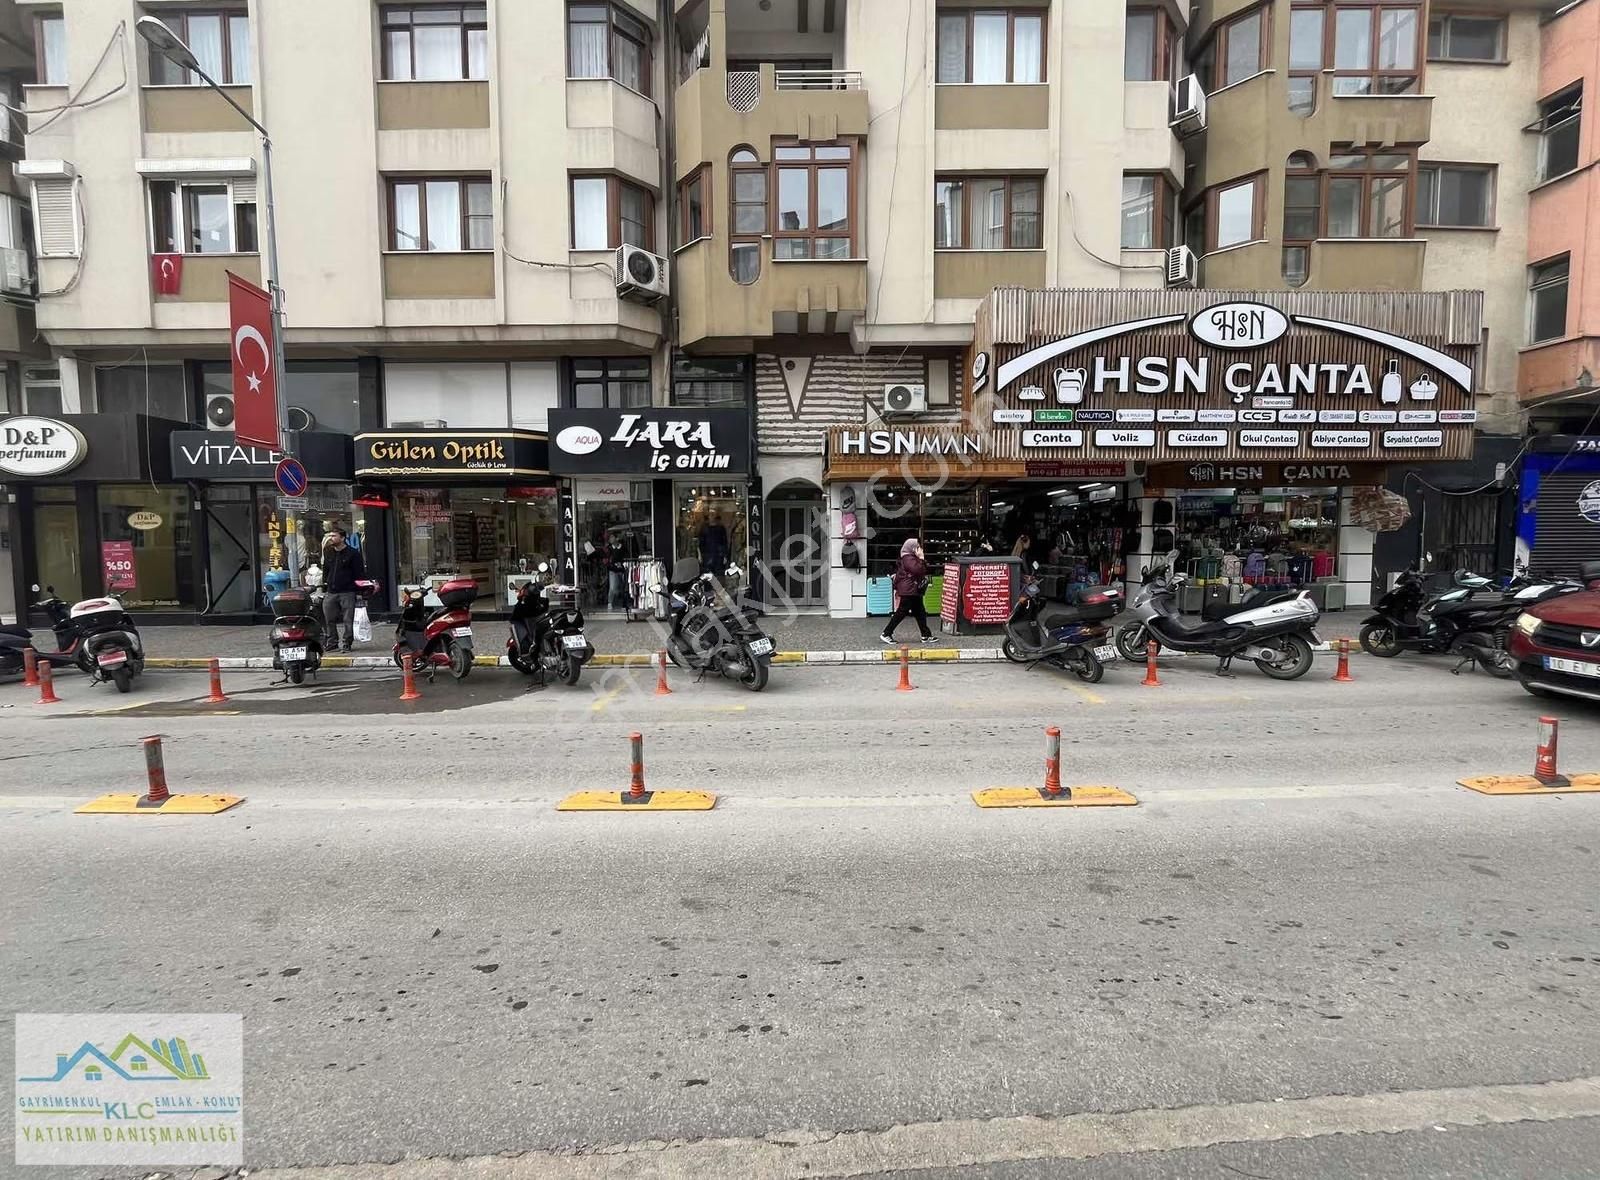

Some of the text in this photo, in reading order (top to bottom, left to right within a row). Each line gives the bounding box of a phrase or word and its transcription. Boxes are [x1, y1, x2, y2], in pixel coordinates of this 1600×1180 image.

[1210, 310, 1266, 341] HSN
[1093, 356, 1373, 403] HSN ÇANTA
[1000, 412, 1025, 420] sisley
[1077, 412, 1111, 420] NAUTICA
[1242, 411, 1273, 421] CCS
[5, 427, 56, 447] D&P
[609, 414, 716, 449] LARA
[574, 436, 600, 446] AQUA
[1033, 433, 1072, 446] Çanta
[1112, 433, 1139, 442] Valiz
[1177, 433, 1218, 442] Cüzdan
[1242, 434, 1297, 445] Okul Çantası
[1313, 435, 1368, 446] Abiye Çantası
[1386, 435, 1440, 445] Seyahat Çantası
[370, 439, 505, 464] Gülen Optik
[650, 450, 731, 472] İÇ GİYİM
[1219, 465, 1351, 483] HSN ÇANTA
[599, 487, 625, 496] AQUA
[563, 506, 574, 570] AQUA
[106, 560, 132, 571] %50
[1552, 659, 1564, 669] 10
